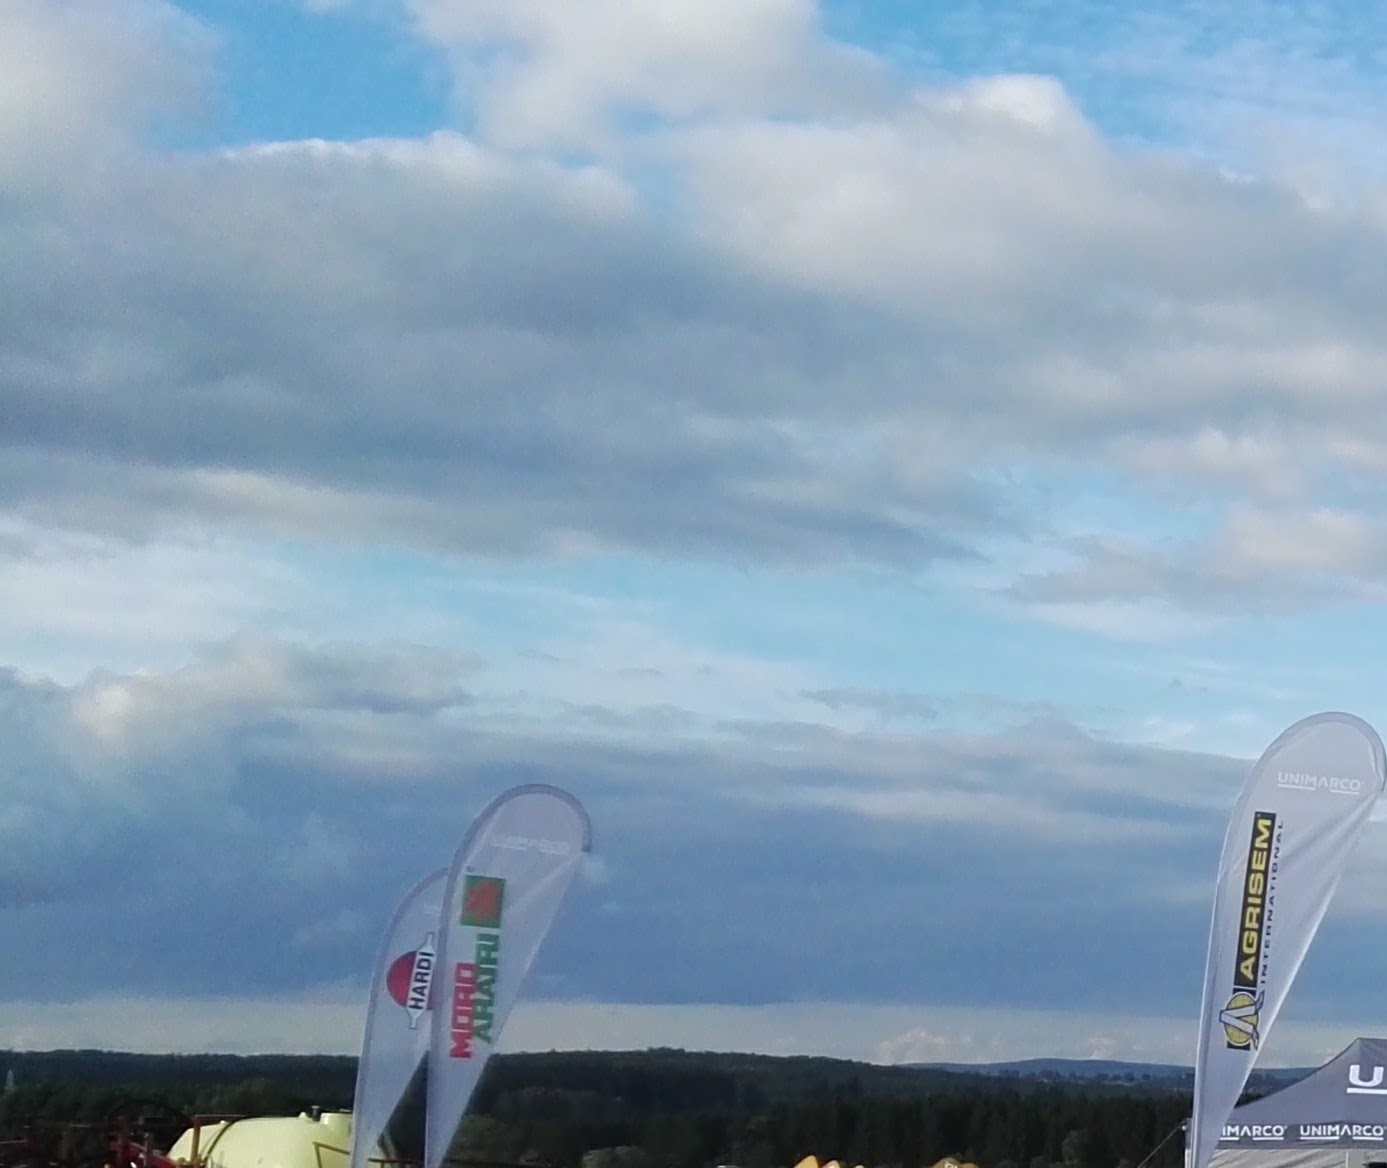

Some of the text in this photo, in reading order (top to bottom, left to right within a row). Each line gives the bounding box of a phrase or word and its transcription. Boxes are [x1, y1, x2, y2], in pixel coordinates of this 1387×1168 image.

[1276, 771, 1361, 792] UNIMARCO
[1239, 818, 1273, 981] AGRISEM
[1259, 820, 1284, 985] INTERNATIONAL
[408, 950, 436, 1010] HARDI
[1222, 1125, 1284, 1136] IMARCO
[1300, 1125, 1384, 1137] UNIMARCO
